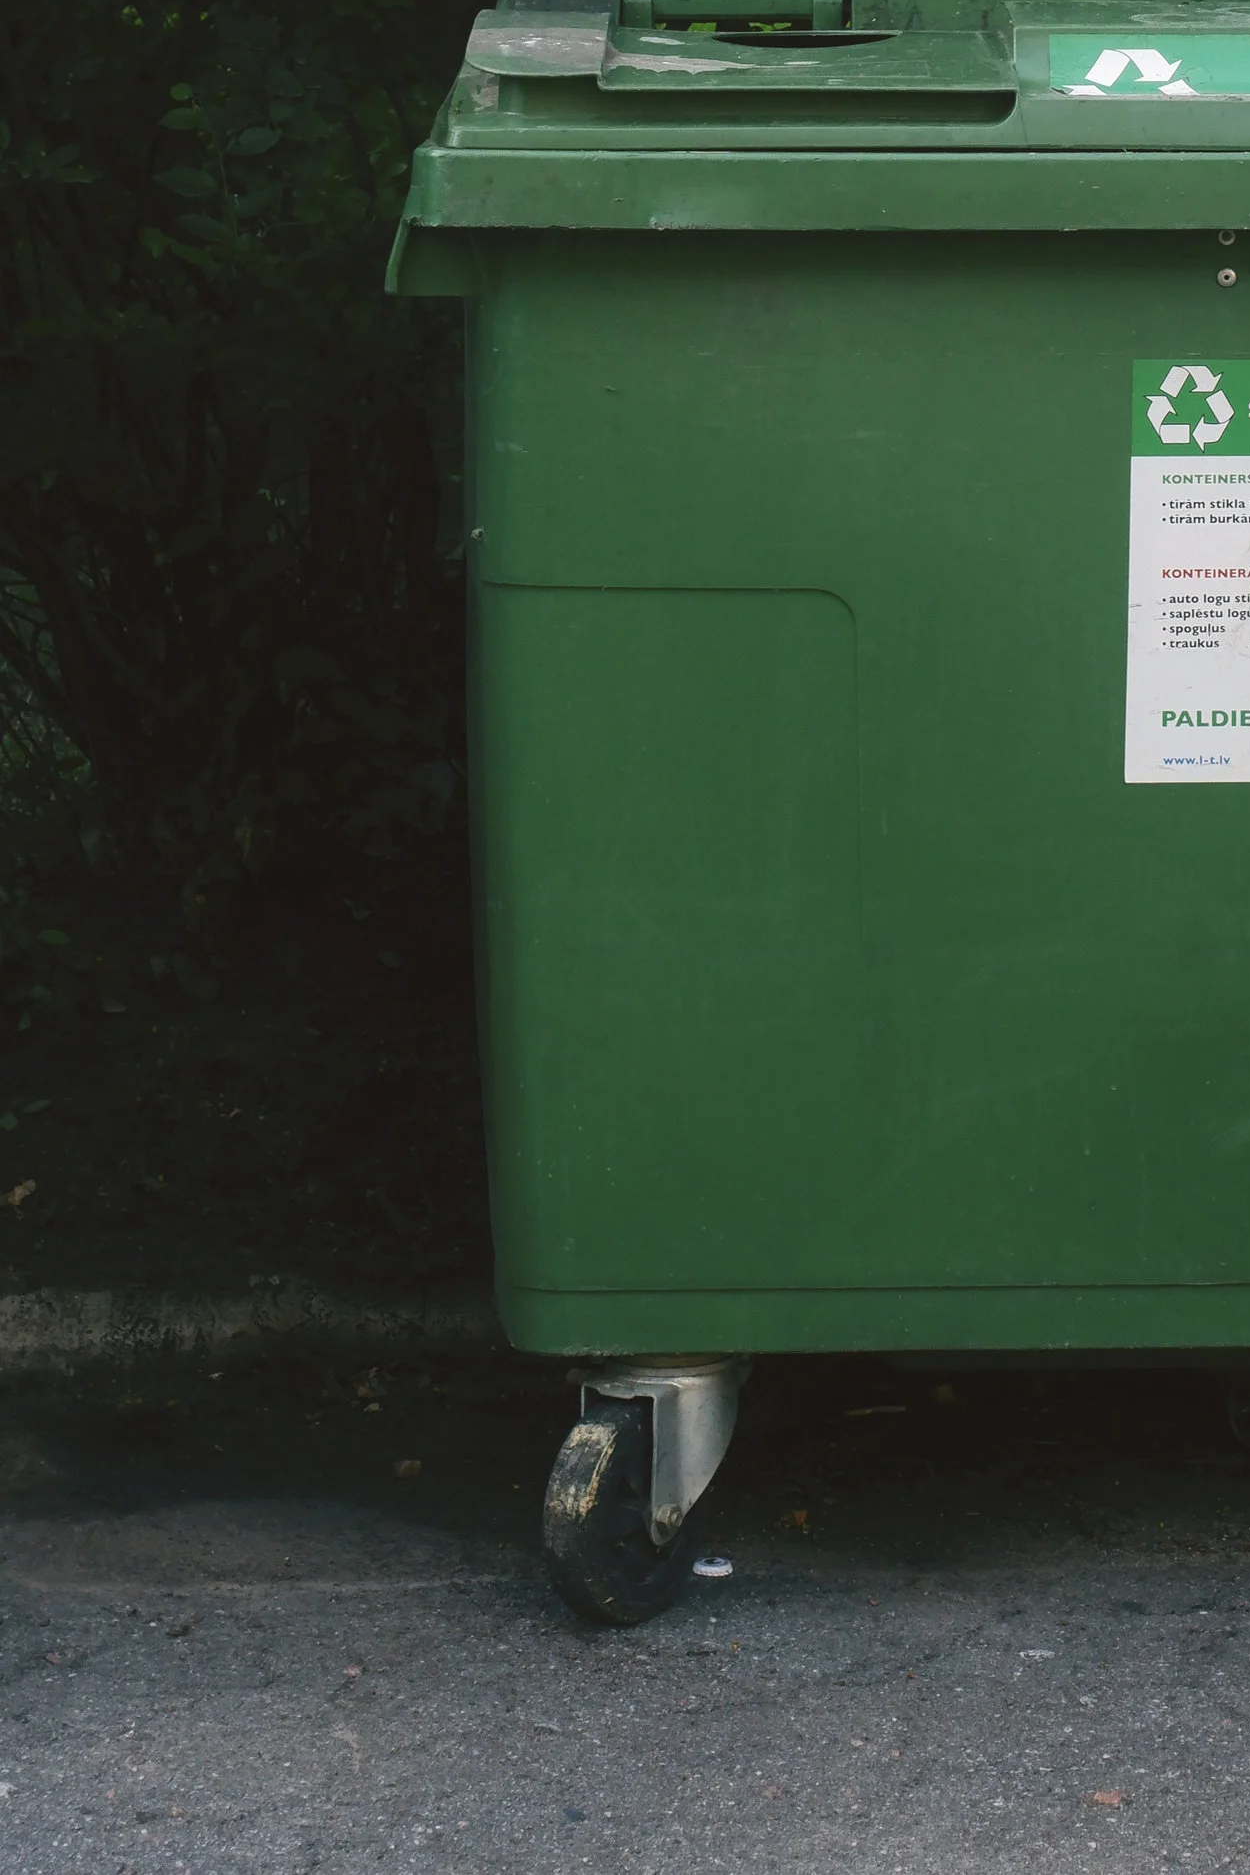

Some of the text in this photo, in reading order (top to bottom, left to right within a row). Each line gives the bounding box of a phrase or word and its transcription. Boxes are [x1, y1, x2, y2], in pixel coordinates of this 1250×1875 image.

[1169, 498, 1206, 509] tīrām
[1210, 498, 1246, 509] stikla
[1169, 513, 1206, 524] tīrām
[1169, 594, 1199, 604] auto
[1203, 593, 1231, 606] logu
[1169, 608, 1223, 622] saplēstu
[1169, 623, 1226, 637] spoguļus
[1169, 638, 1220, 649] traukus
[1163, 755, 1231, 765] www.l-t.lv
